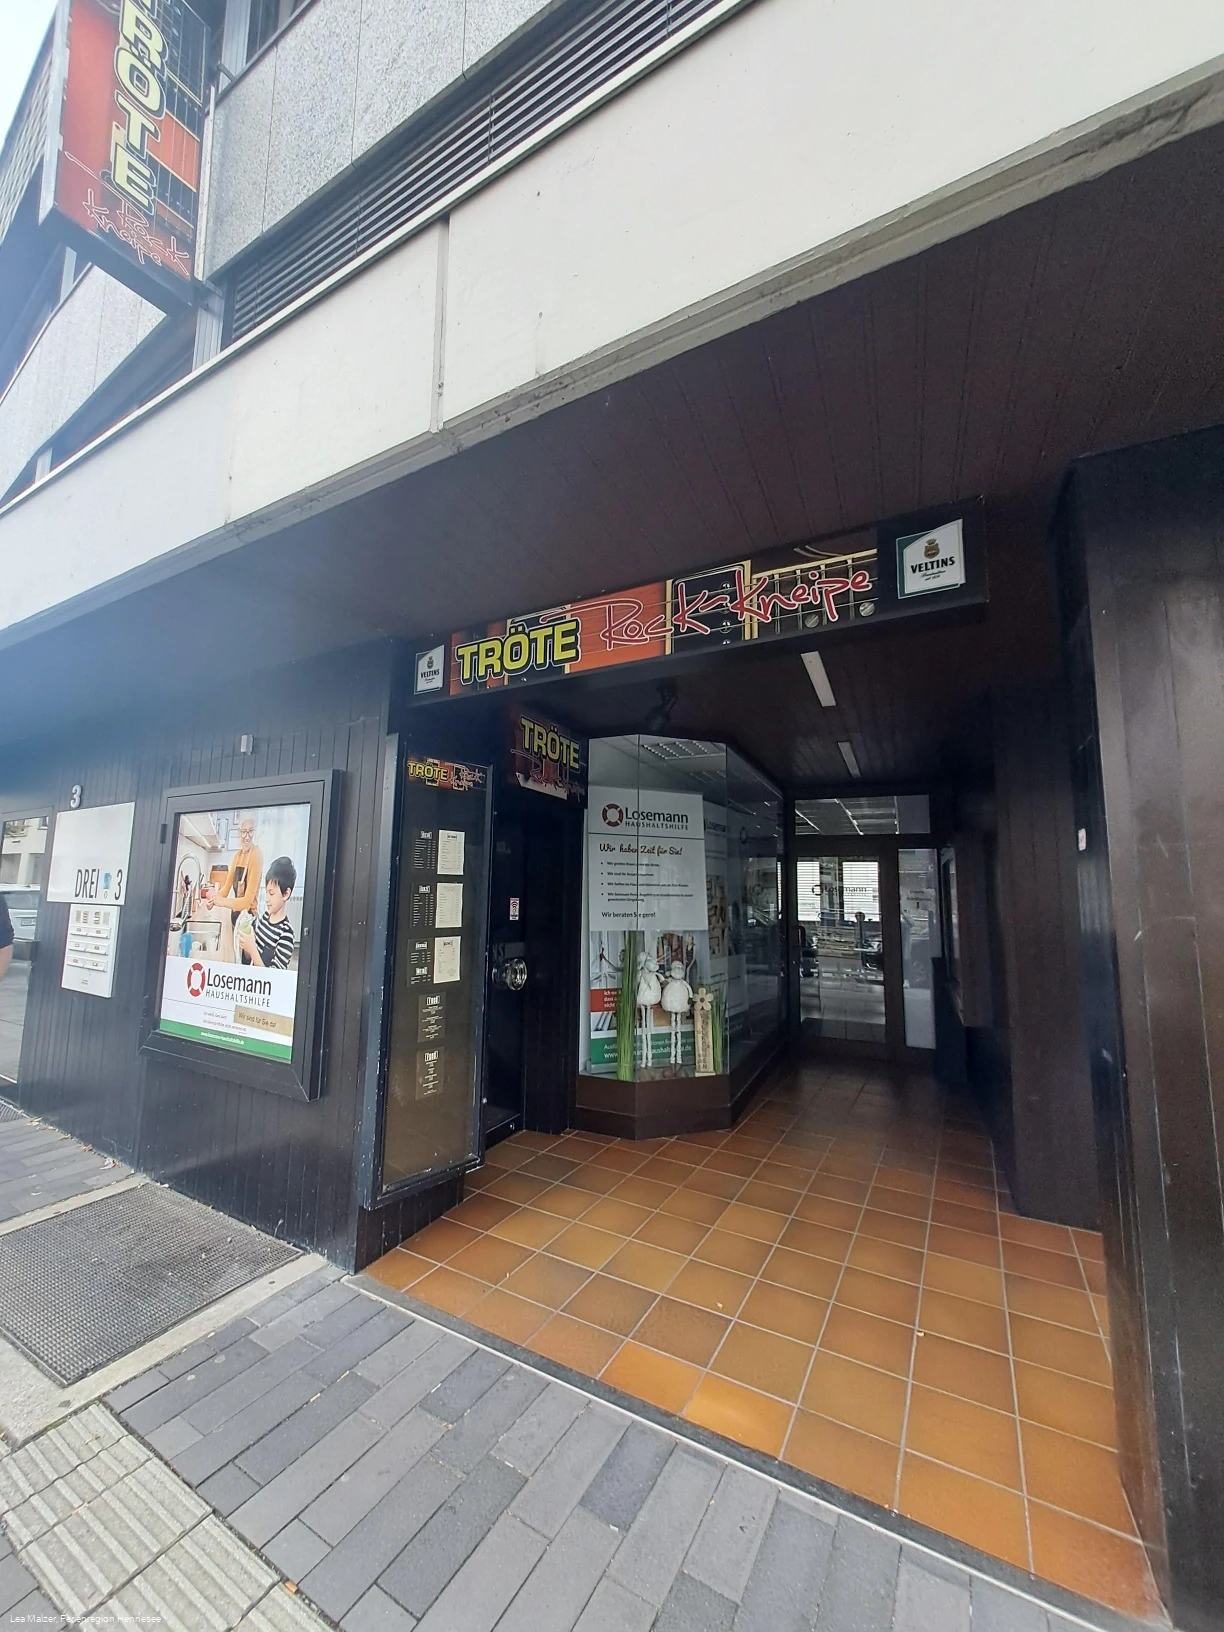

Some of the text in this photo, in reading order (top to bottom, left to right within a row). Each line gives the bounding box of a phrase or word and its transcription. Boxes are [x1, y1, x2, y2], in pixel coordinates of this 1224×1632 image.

[911, 556, 955, 574] VELTINS
[456, 617, 582, 686] TRÖTE
[420, 668, 440, 679] VELTINS
[519, 714, 581, 774] TRÖTE
[70, 784, 82, 808] 3
[625, 807, 688, 823] Losemann
[625, 821, 689, 831] HAUSHALTSHILFE
[600, 843, 683, 857] Wir haben Zeit für Sie!
[75, 868, 123, 901] DREI 3
[207, 968, 272, 996] Losemann
[205, 988, 270, 1008] HAUSHALTSHILFE
[238, 1012, 247, 1020] Wir
[246, 1014, 256, 1023] sind
[261, 1018, 269, 1027] Sie
